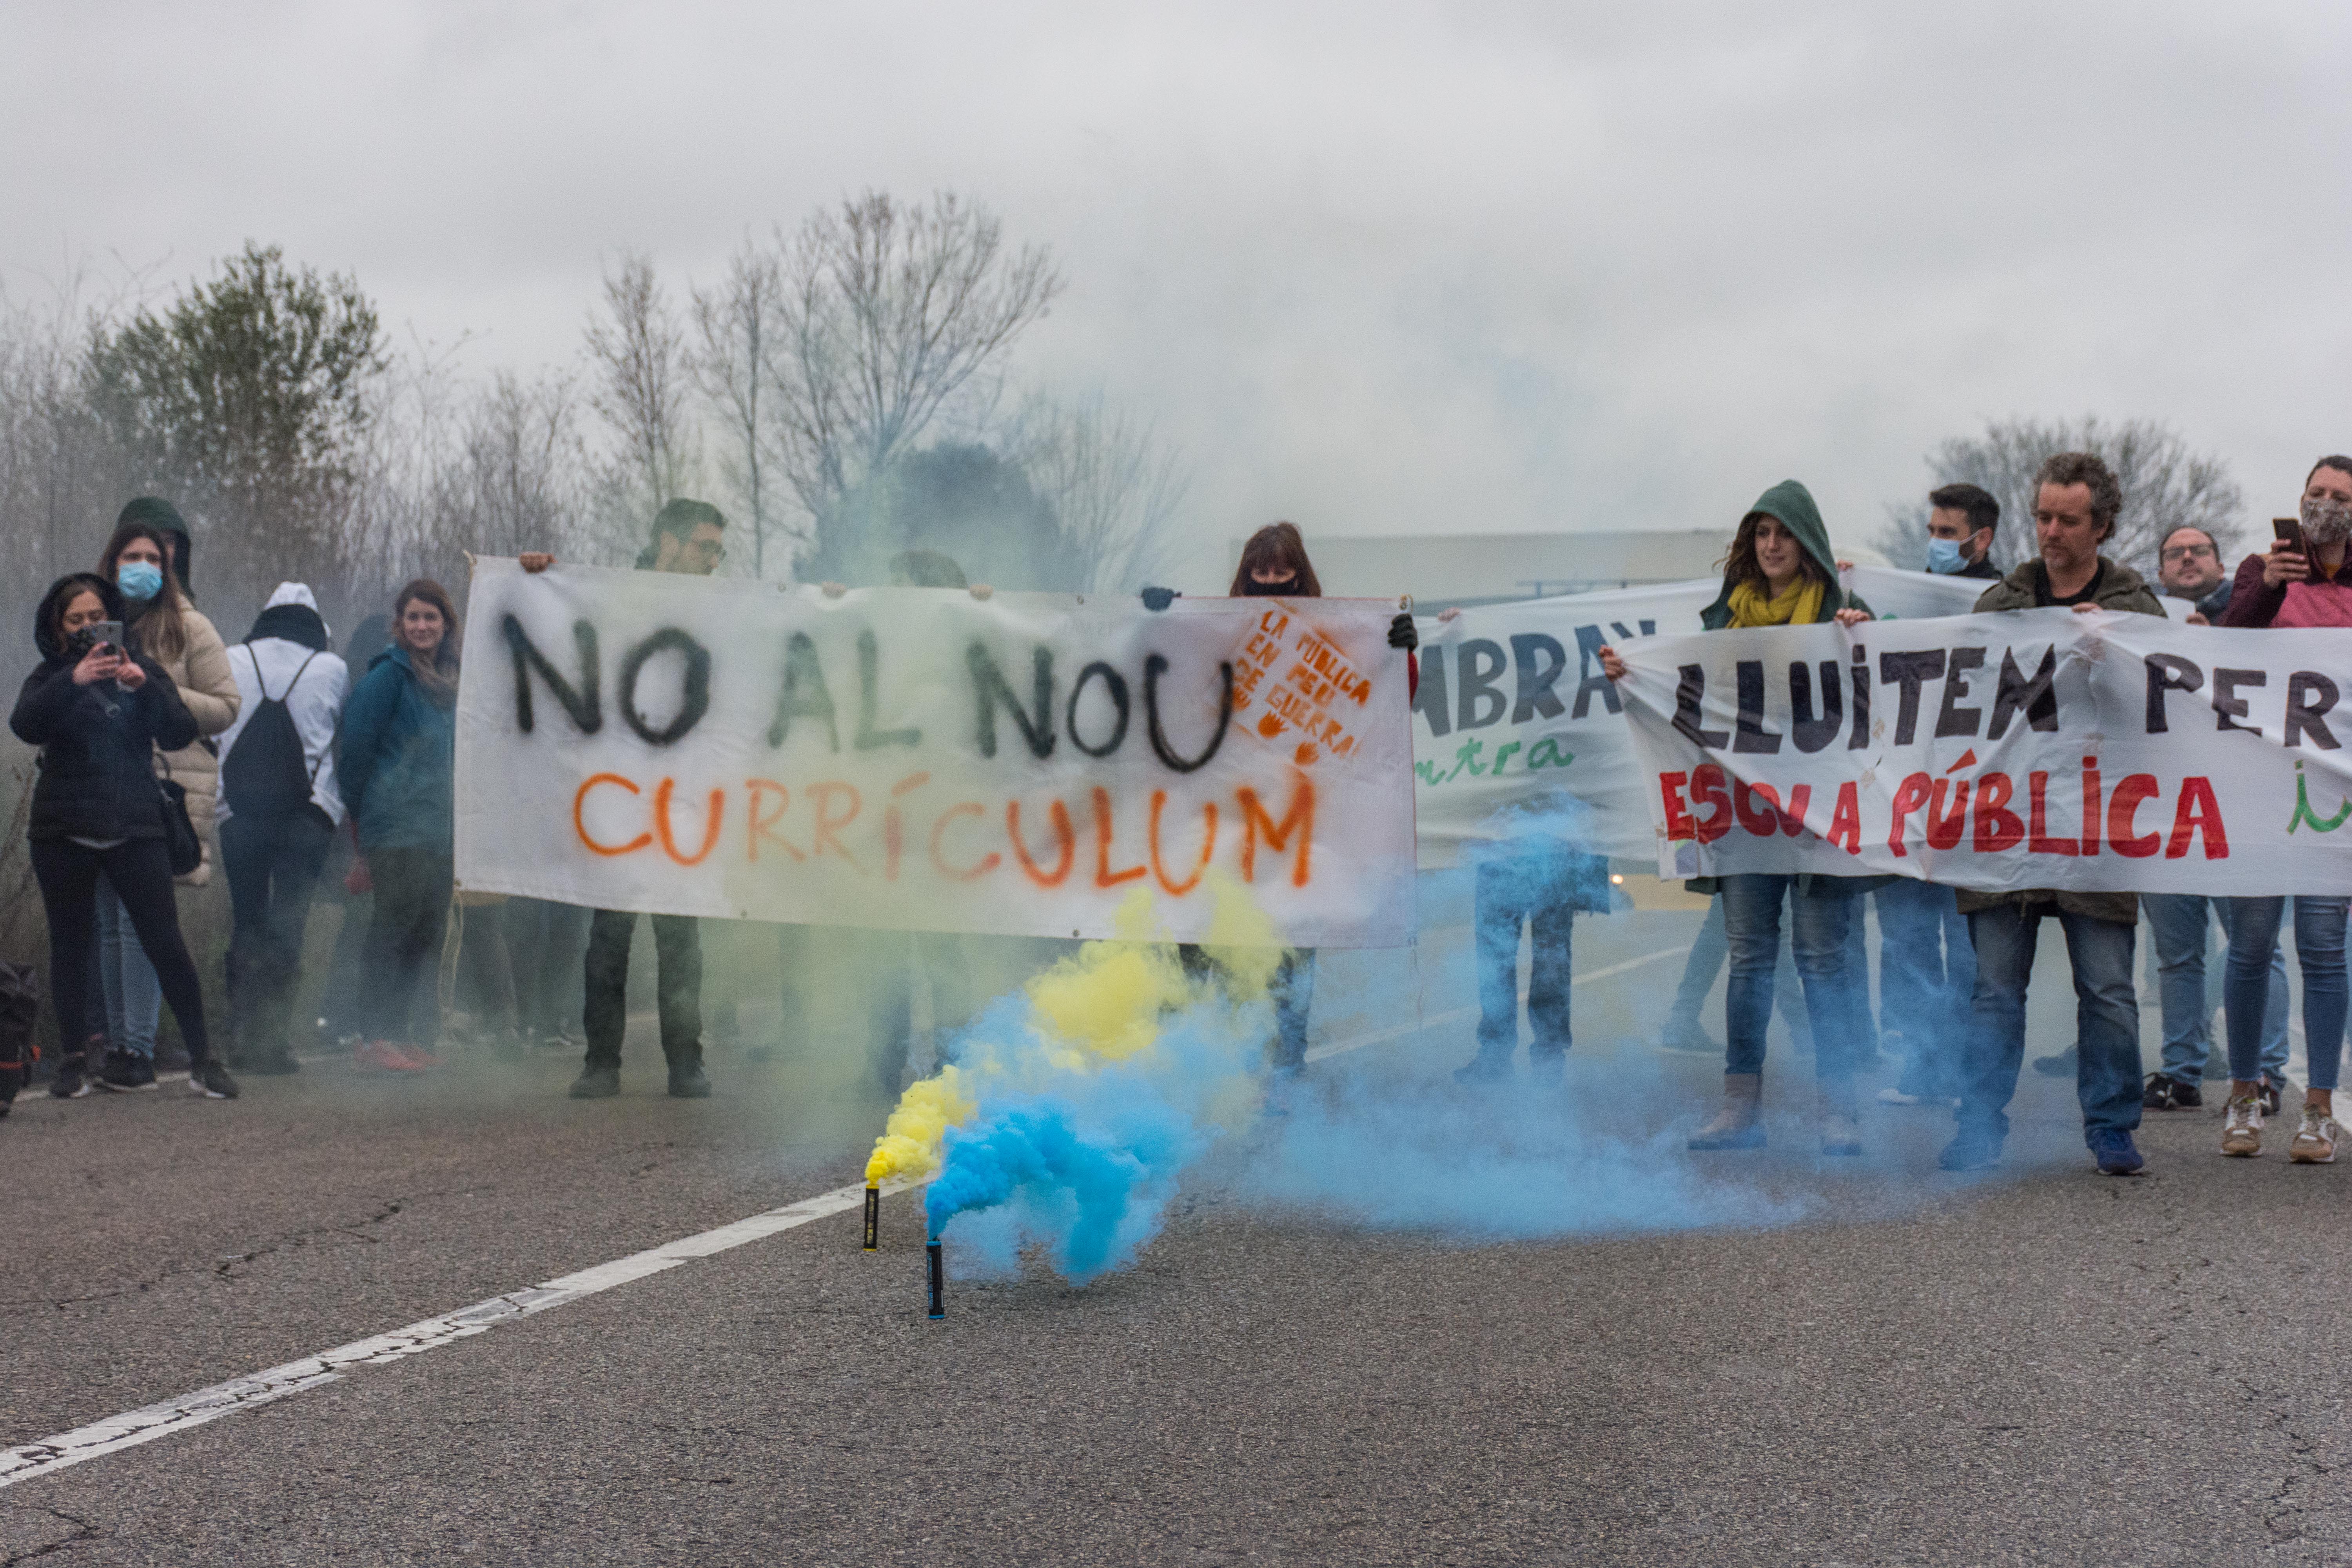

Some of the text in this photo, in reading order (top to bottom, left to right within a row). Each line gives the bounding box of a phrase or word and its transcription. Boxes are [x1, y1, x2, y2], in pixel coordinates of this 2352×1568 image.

[1245, 633, 1336, 707] EN PEU
[1260, 610, 1289, 640] LA
[501, 613, 1233, 773] NO AL NOU
[2145, 653, 2341, 750] PER
[573, 769, 1316, 896] CURRÍCULUM
